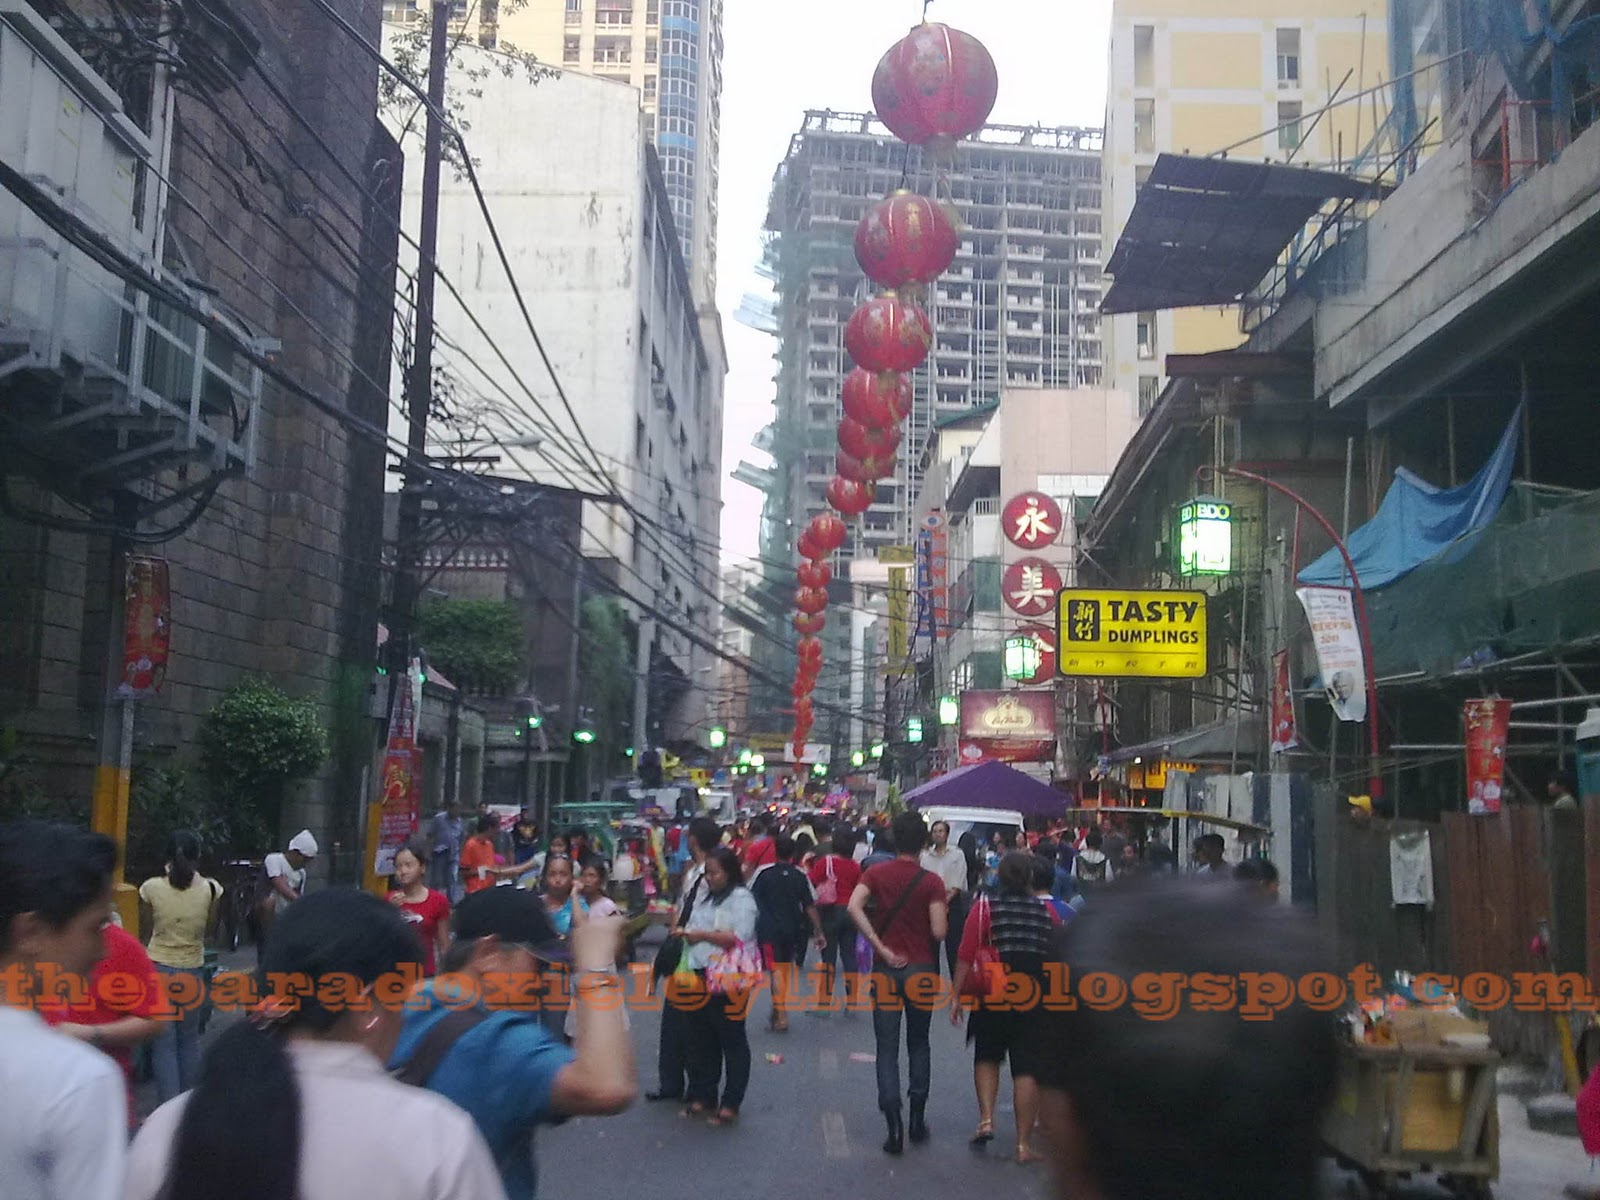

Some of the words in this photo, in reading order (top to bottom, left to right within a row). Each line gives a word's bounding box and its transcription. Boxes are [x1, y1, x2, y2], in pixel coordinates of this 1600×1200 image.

[1197, 503, 1231, 519] BDO
[1107, 600, 1199, 623] TASTY
[1108, 630, 1199, 644] DUMPLINGS
